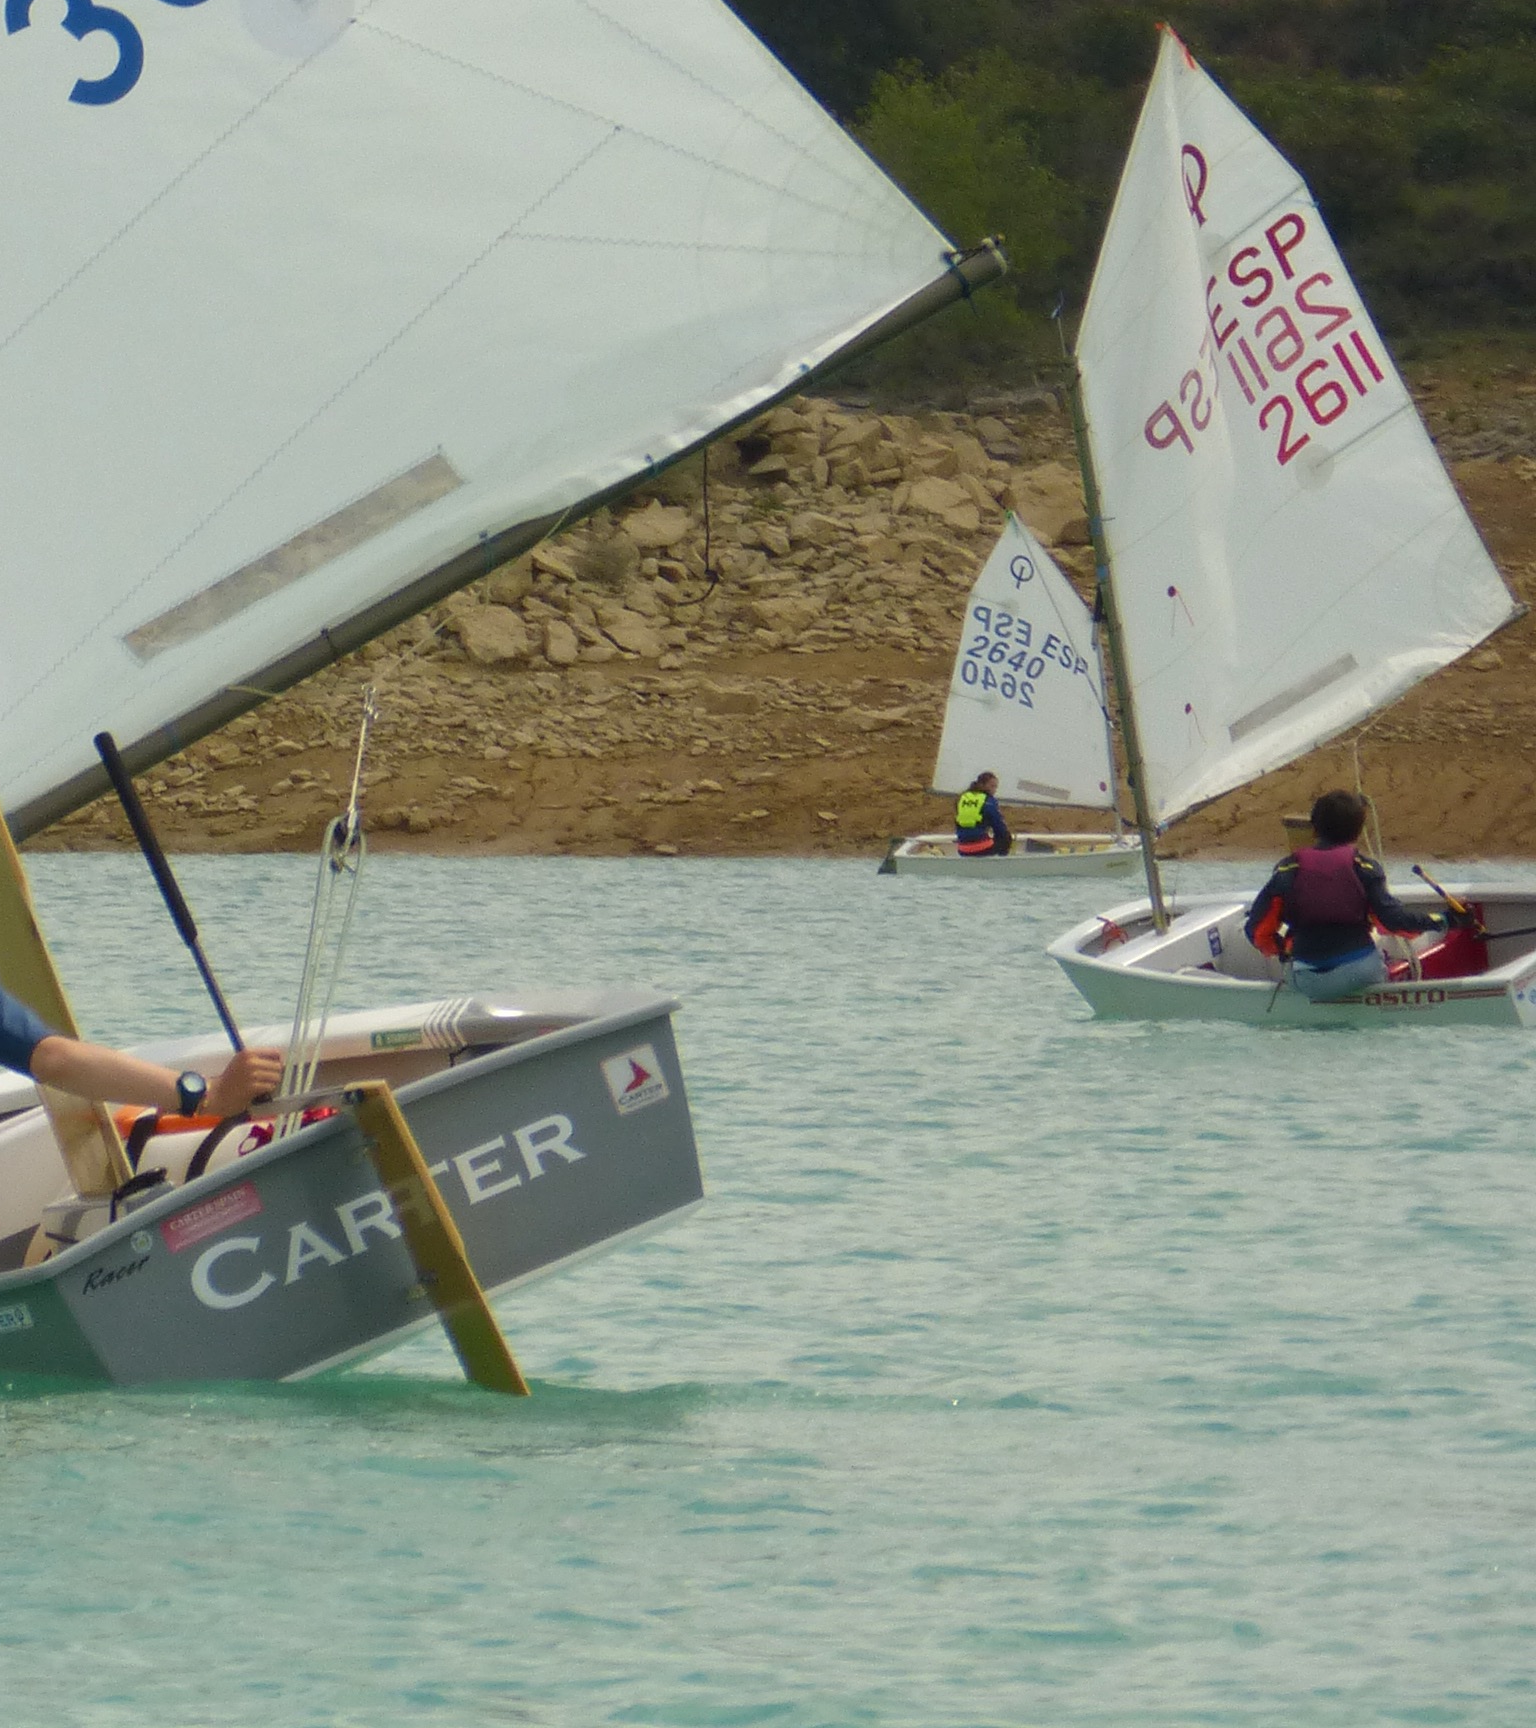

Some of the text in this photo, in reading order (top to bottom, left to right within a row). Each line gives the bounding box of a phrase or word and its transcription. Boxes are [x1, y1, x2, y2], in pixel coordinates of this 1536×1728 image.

[1207, 213, 1306, 351] ESP
[1258, 330, 1385, 467] 2611
[966, 635, 1046, 680] 2640
[1041, 633, 1089, 675] ESP
[961, 799, 979, 808] HH
[190, 1113, 588, 1310] CARER
